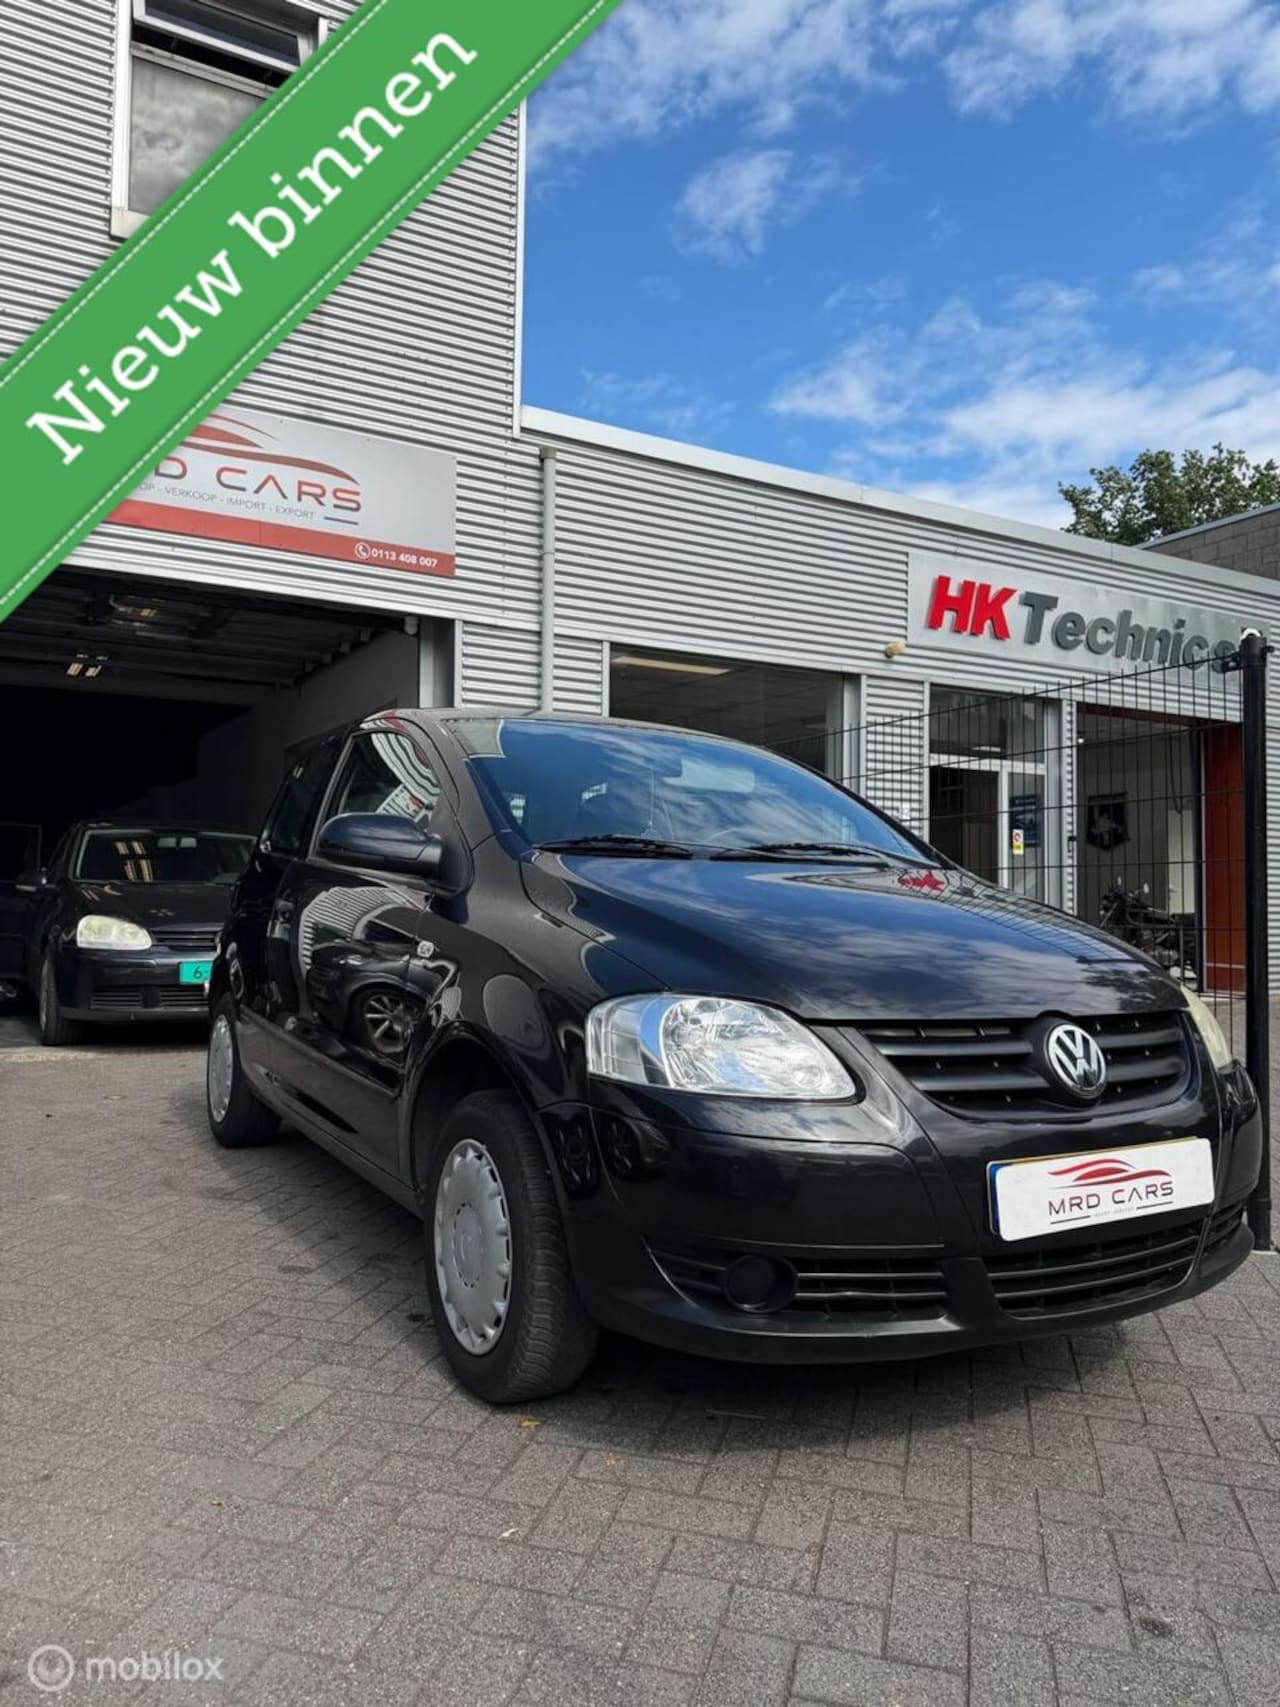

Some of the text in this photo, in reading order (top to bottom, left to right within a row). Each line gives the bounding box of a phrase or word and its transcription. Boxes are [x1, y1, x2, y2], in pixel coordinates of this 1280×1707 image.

[165, 485, 217, 502] VERKOOP
[226, 496, 266, 511] IMPORT
[275, 505, 314, 519] EXPORT
[216, 466, 362, 513] CARS
[371, 547, 397, 561] 0113
[1048, 1192, 1101, 1217] MRD
[1111, 1180, 1174, 1205] CARS
